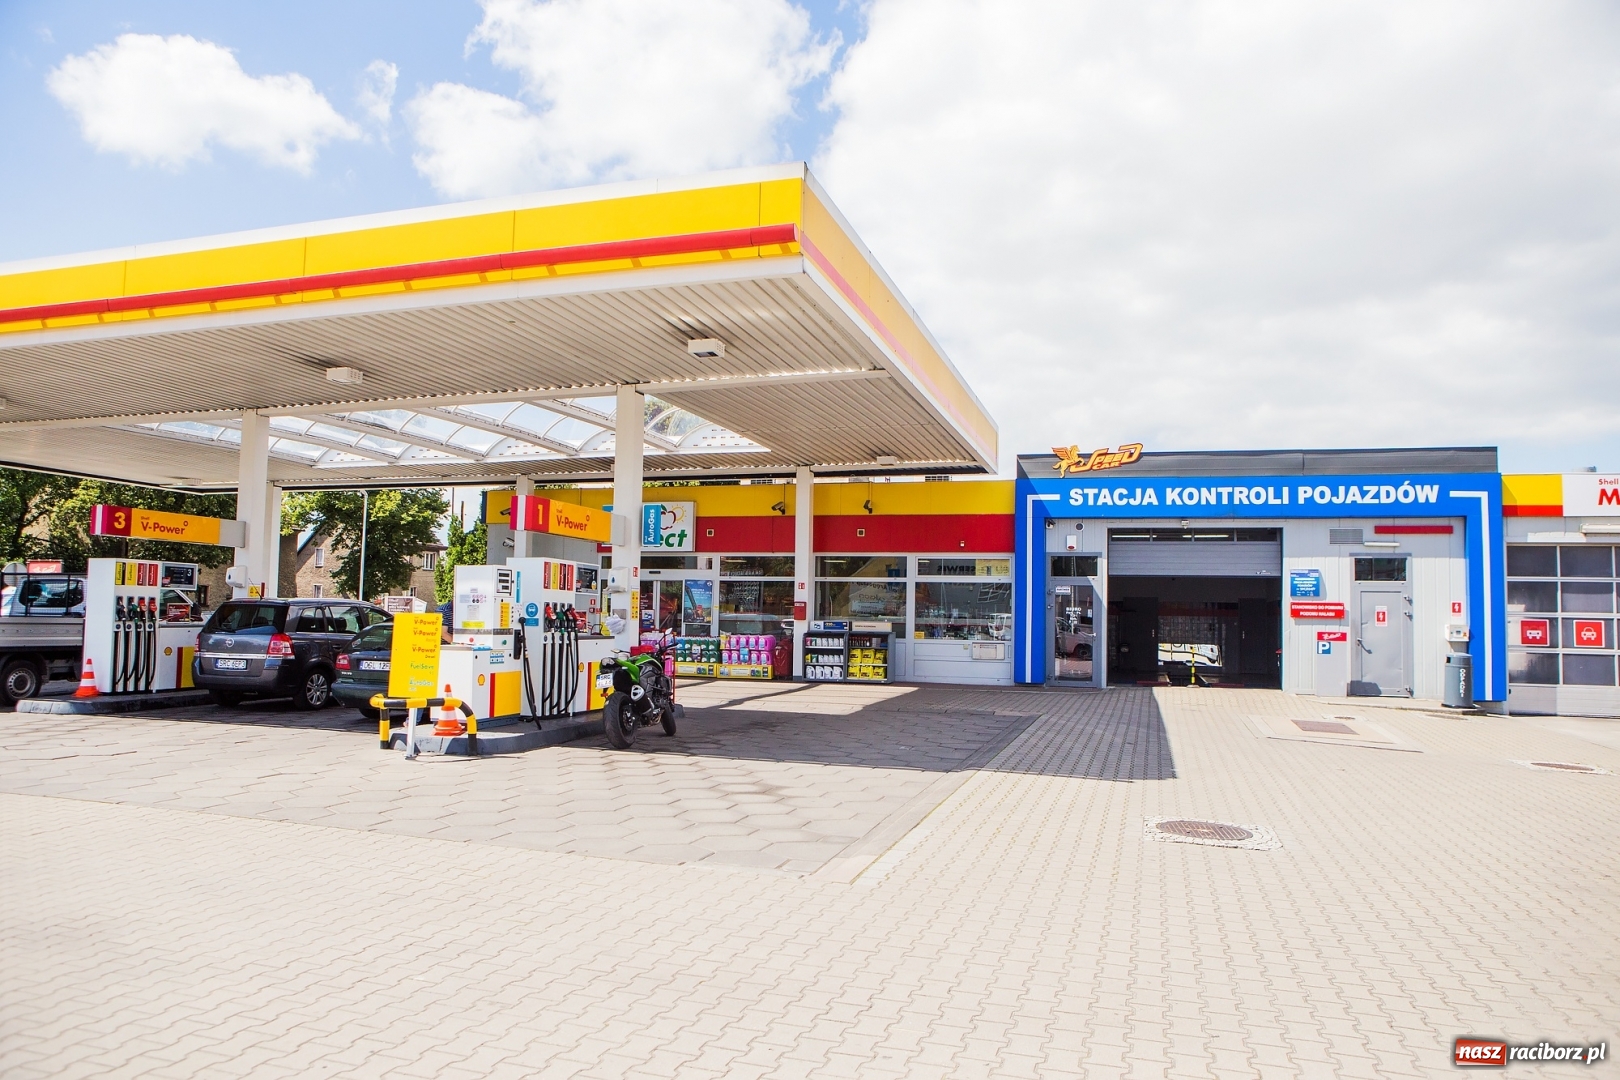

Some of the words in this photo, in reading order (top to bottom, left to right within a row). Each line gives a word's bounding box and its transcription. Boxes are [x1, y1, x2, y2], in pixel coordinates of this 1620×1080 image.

[1069, 443, 1143, 473] SPEED
[1092, 462, 1122, 471] CAR
[1069, 487, 1159, 506] STACJA
[1165, 486, 1289, 506] KONTROLI
[1298, 480, 1440, 505] POJAZDÓW
[114, 511, 126, 529] 3
[537, 504, 543, 525] 1
[556, 515, 588, 531] V-Power
[141, 521, 186, 535] V-Power
[1318, 642, 1330, 654] P
